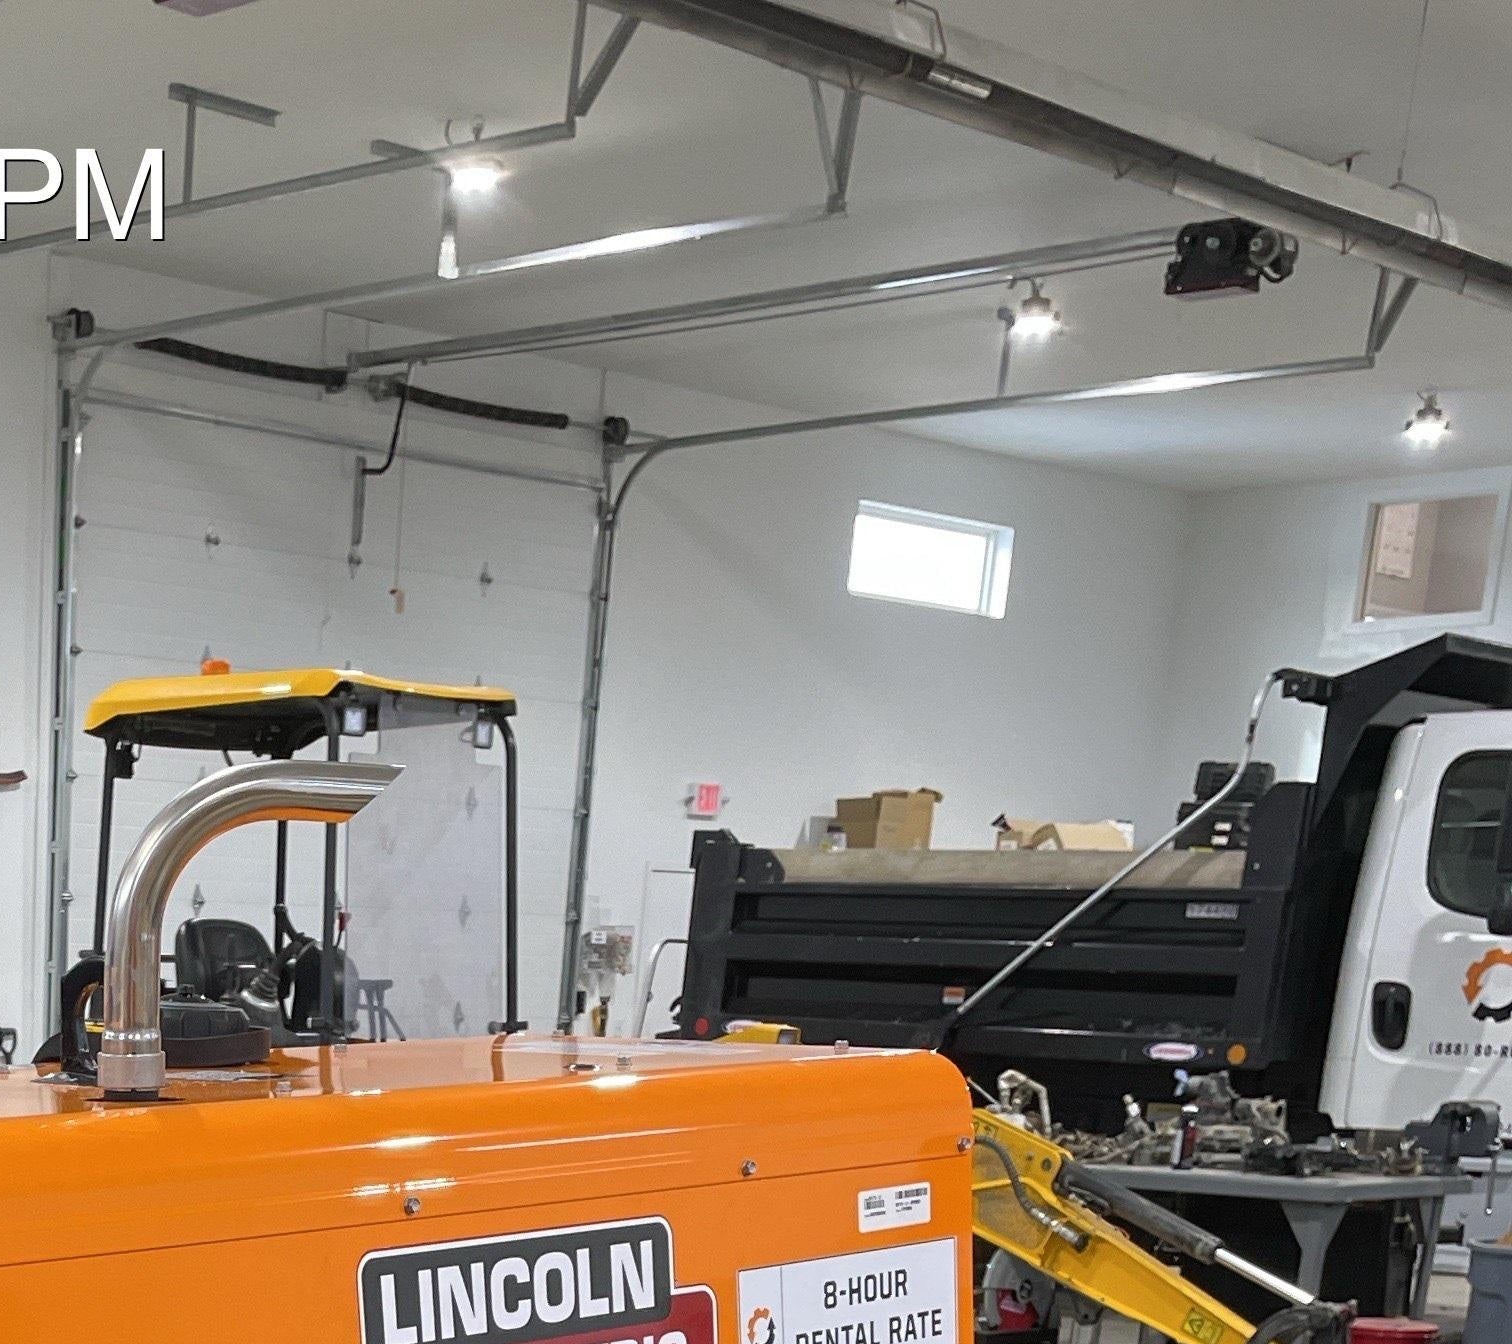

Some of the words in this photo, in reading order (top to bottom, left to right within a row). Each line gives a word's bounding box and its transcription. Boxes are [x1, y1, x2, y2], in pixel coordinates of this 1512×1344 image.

[1429, 1040, 1469, 1056] (888)
[1474, 1042, 1512, 1059] 80-R
[822, 1267, 910, 1312] 8-HOUR
